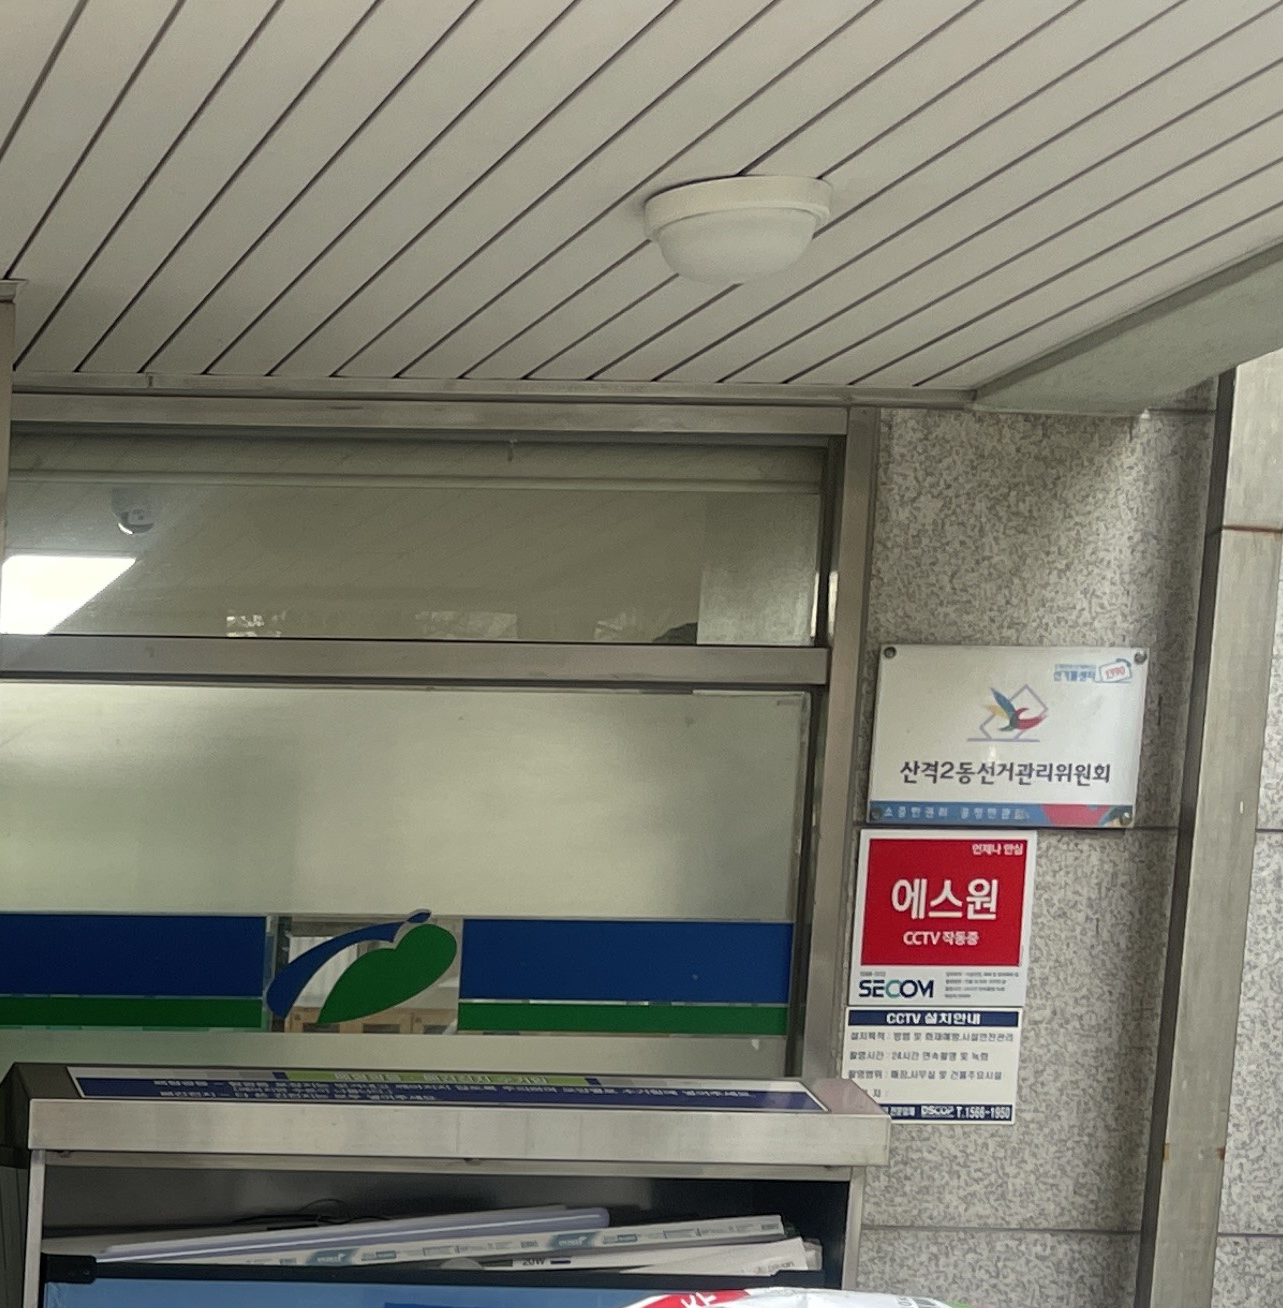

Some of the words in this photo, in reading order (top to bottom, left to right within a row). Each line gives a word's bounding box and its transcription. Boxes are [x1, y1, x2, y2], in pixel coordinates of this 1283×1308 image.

[899, 760, 1111, 786] 산격2동선거관리위원회
[891, 878, 997, 920] 에스원
[903, 931, 940, 945] CCTV
[942, 931, 979, 946] 작동중
[859, 980, 935, 998] SECOM
[886, 1013, 921, 1024] CCTV
[925, 1013, 981, 1025] 설치안내
